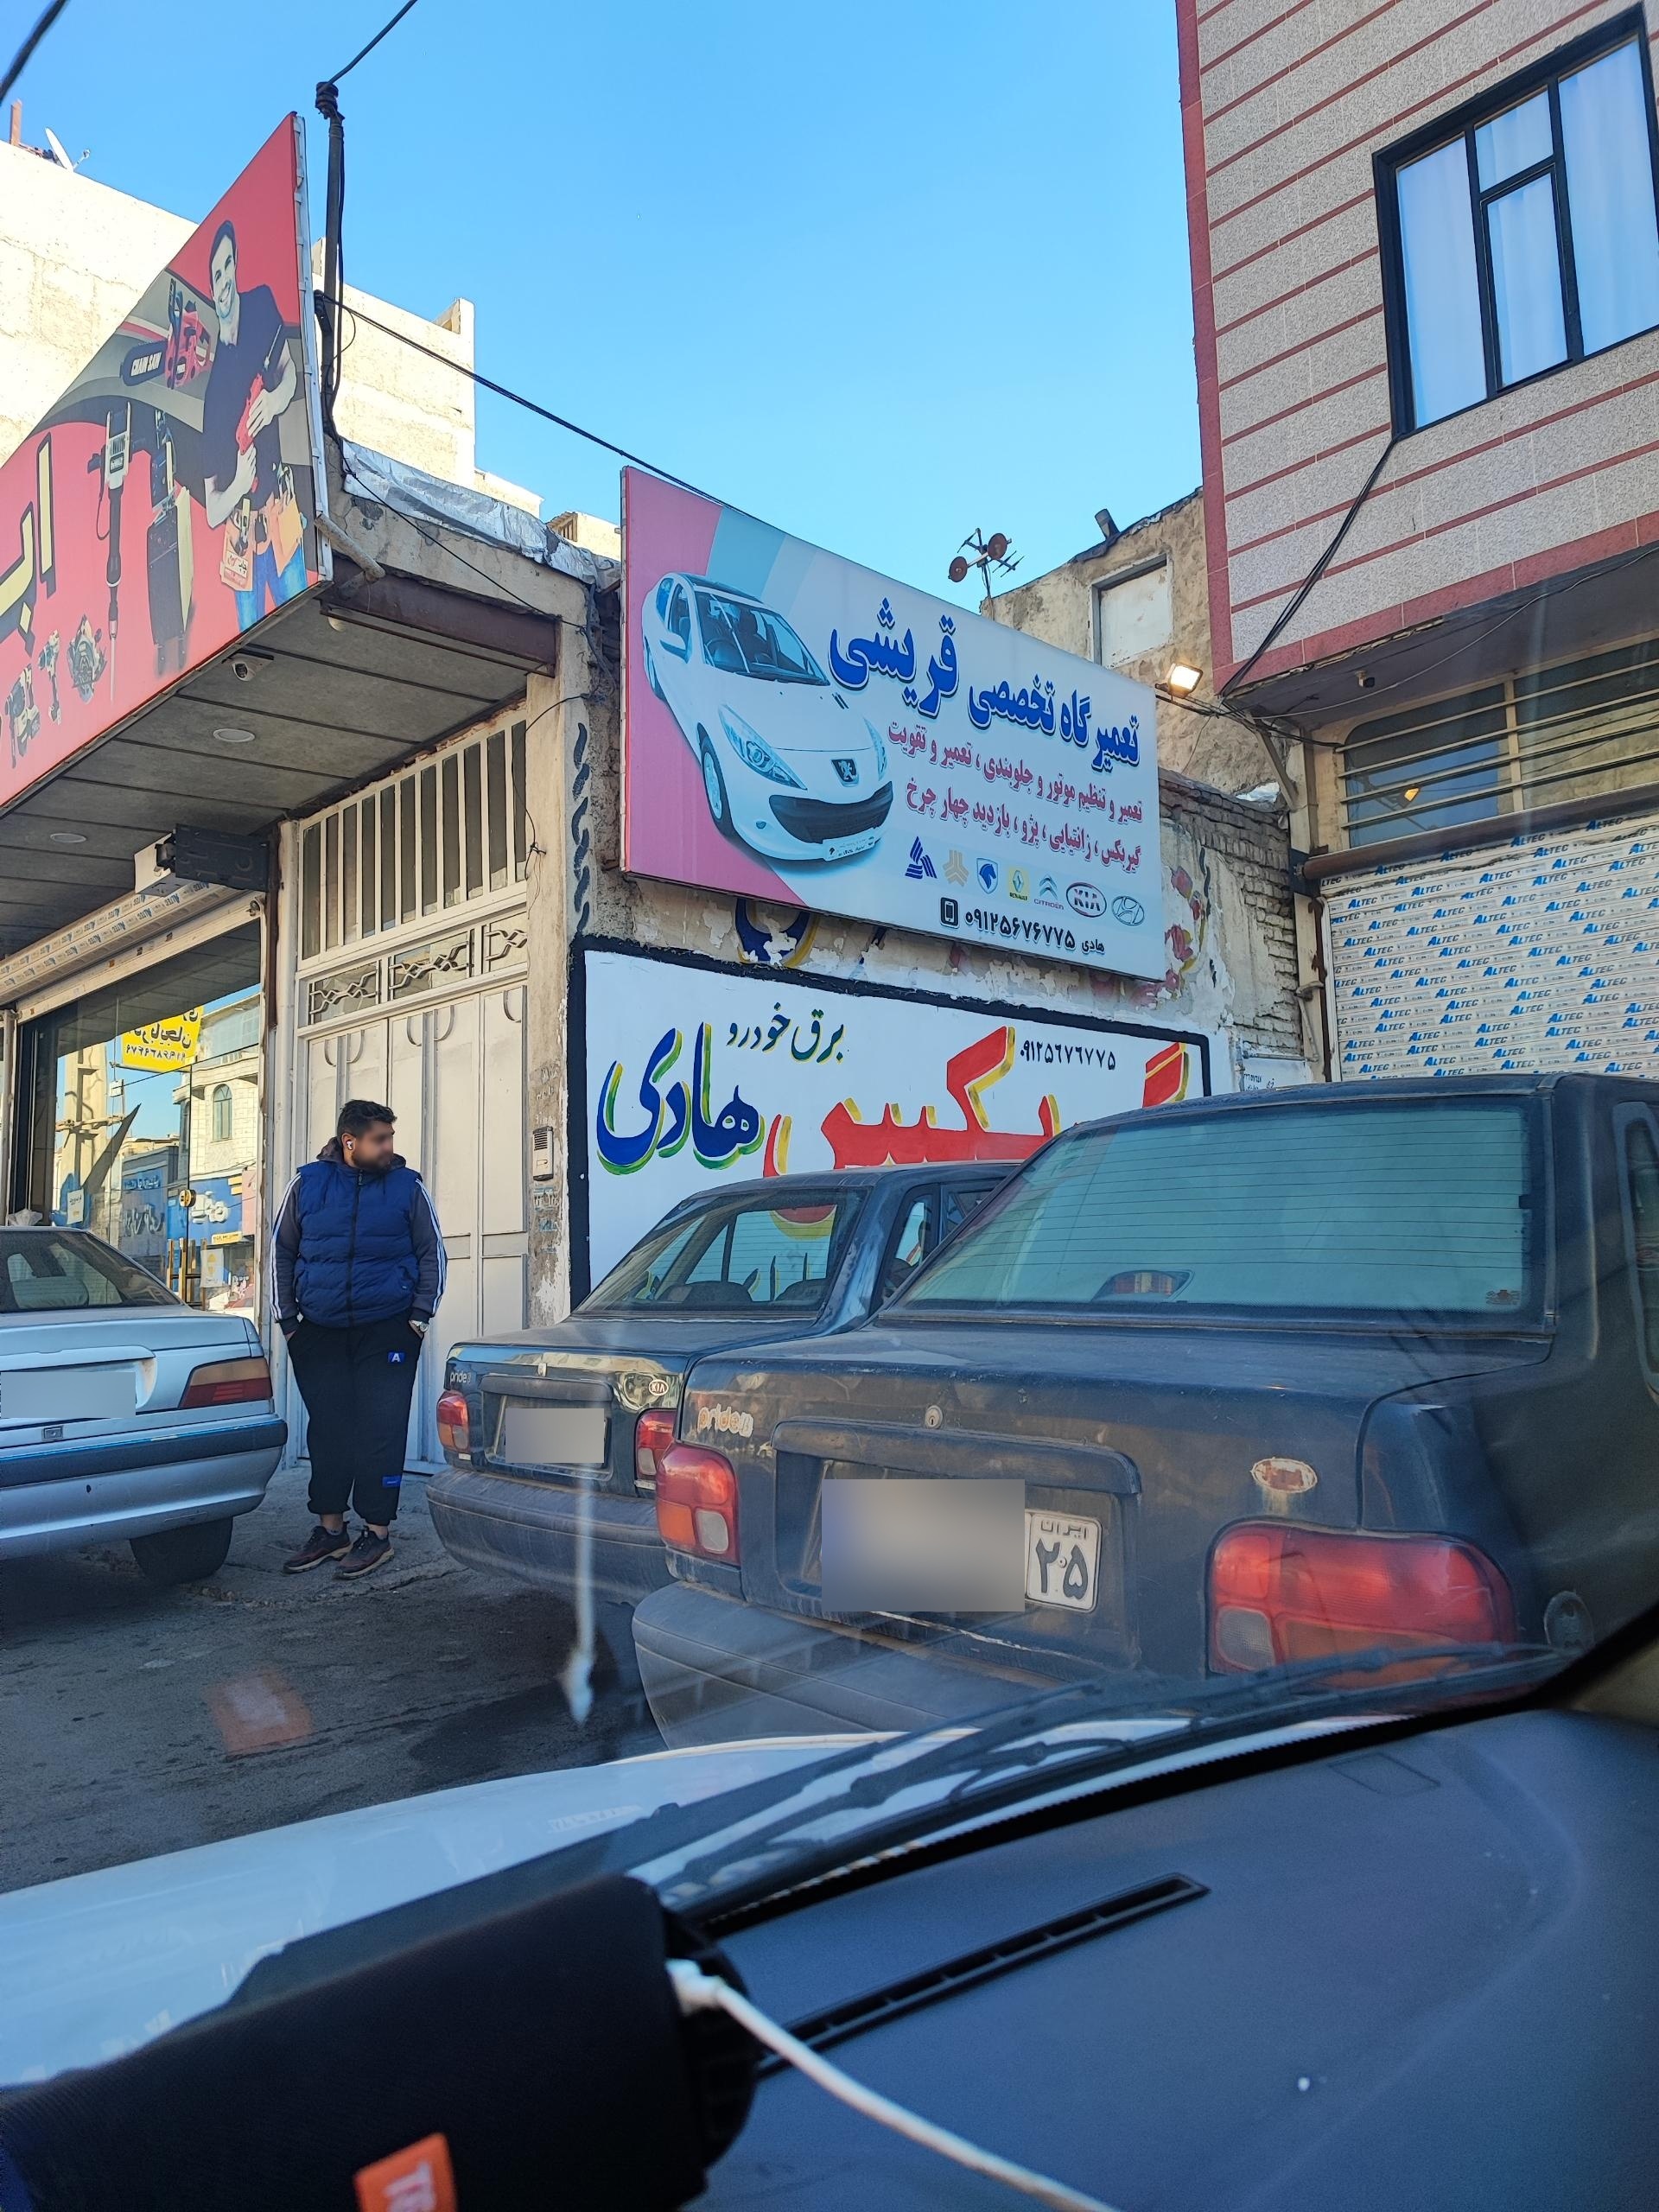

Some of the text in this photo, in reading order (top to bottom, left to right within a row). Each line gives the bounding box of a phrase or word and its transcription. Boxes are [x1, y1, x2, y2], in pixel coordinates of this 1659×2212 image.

[830, 597, 959, 717] قریشی
[969, 674, 1055, 734] تخصصی
[888, 721, 926, 756] تقویت
[930, 739, 938, 763] و
[941, 741, 972, 768] تعمیر
[906, 777, 937, 817] چرخ
[1037, 775, 1044, 798] و
[1046, 773, 1076, 804] موتور
[1078, 783, 1107, 810] تنظیم
[940, 787, 969, 828] چهار
[973, 804, 1010, 836] بازدید
[1109, 798, 1116, 820] و
[1118, 800, 1143, 822] تعمیر
[1630, 842, 1658, 854] ALTE
[1321, 877, 1342, 887] LTEC
[1008, 891, 1028, 901] RENAULT
[1073, 888, 1101, 912] KIA
[1081, 938, 1105, 956] هادی
[726, 1001, 845, 1064] برق خودرو
[596, 1021, 765, 1173] هادی
[391, 1352, 401, 1363] A
[651, 1382, 666, 1393] KIA
[1040, 1519, 1087, 1540] ایران
[1035, 1537, 1089, 1600] ۲۵
